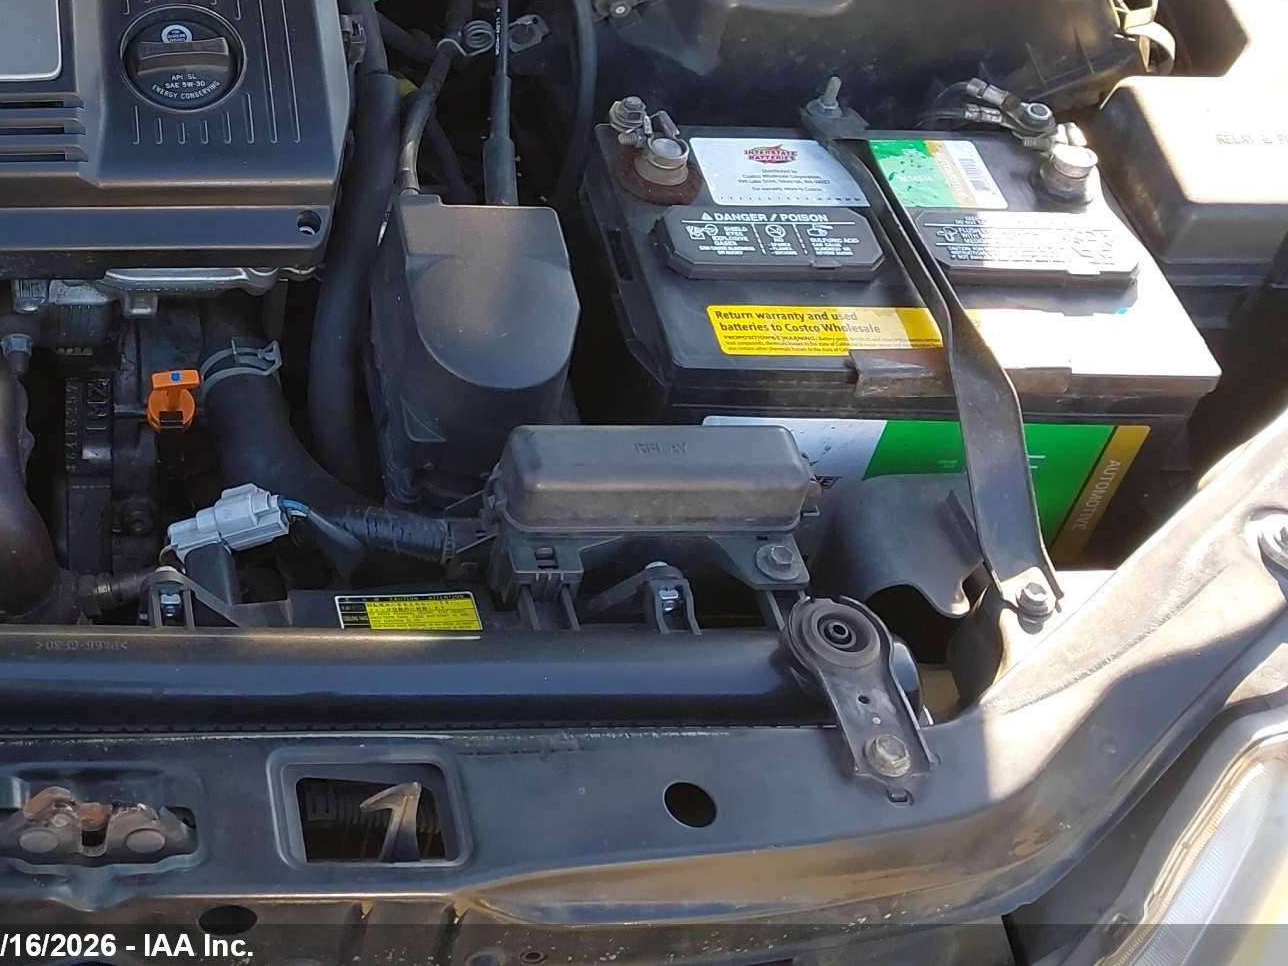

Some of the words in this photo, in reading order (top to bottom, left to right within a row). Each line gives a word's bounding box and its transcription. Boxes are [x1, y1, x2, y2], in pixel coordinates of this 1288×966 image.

[182, 81, 206, 89] 5W-30
[152, 84, 178, 99] ENERGY
[180, 80, 221, 100] CONSERVING
[744, 148, 798, 156] INTERSTATE
[747, 154, 796, 162] BATTERIES
[714, 214, 768, 222] DANGER
[779, 214, 829, 222] POISON
[715, 311, 752, 320] Return
[755, 312, 804, 322] warranty
[808, 312, 828, 321] and
[831, 312, 858, 321] used
[719, 322, 769, 331] batteries
[771, 323, 782, 331] to
[784, 323, 820, 332] Costco
[821, 323, 881, 333] Wholesale
[1078, 459, 1121, 530] AUTOMOTIVE
